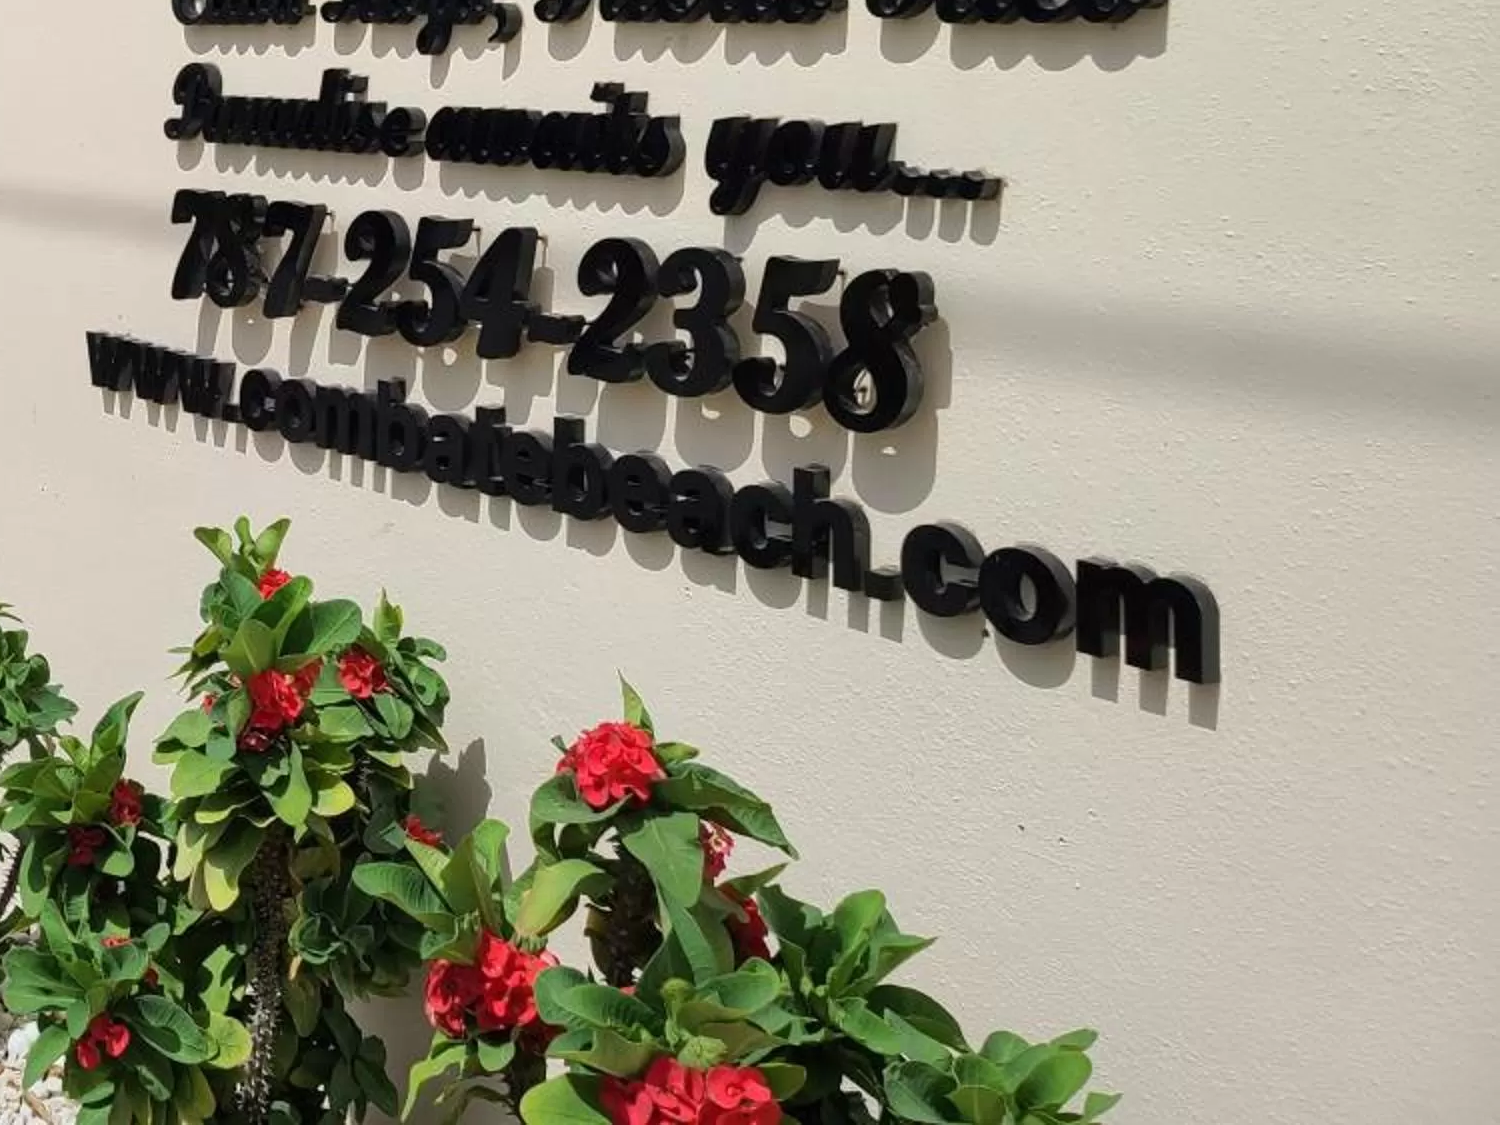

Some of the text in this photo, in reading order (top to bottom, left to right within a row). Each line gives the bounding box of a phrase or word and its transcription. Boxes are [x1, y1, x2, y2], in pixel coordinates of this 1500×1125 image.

[164, 62, 427, 157] Paradise
[170, 187, 938, 434] 787-254-2358
[84, 329, 1221, 686] www.combatebeach.com
